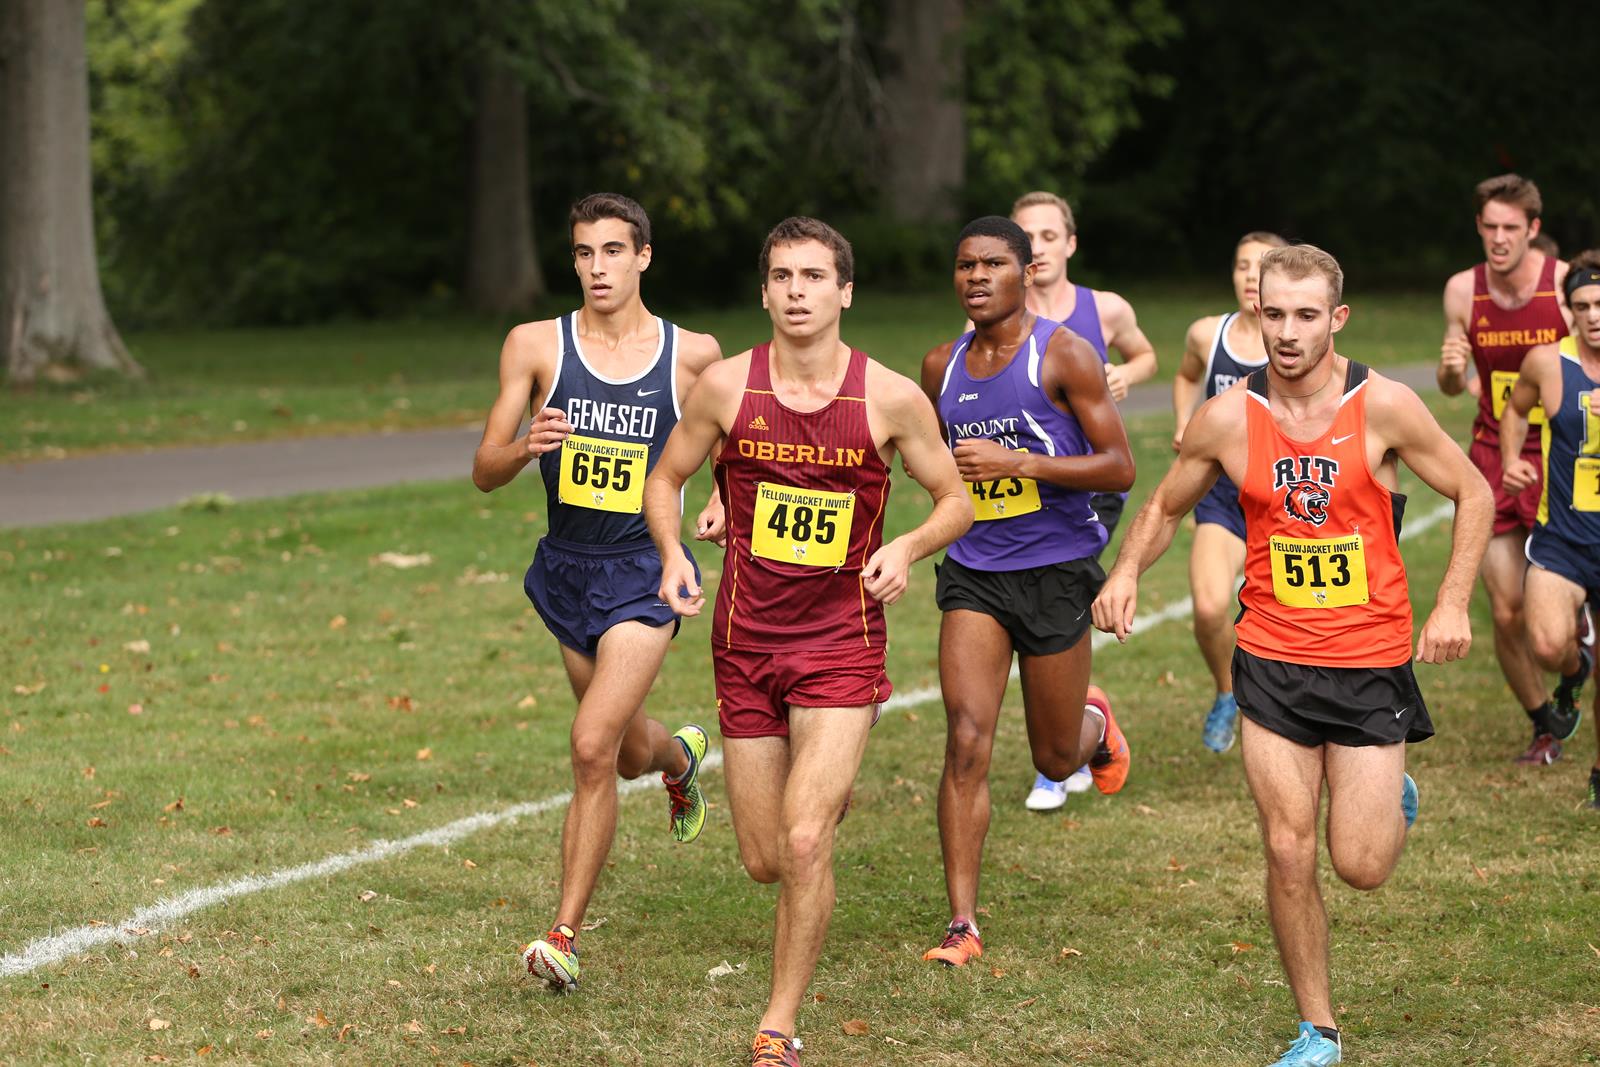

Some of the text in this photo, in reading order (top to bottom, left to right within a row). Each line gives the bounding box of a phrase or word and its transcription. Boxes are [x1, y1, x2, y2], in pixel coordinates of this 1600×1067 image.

[1477, 328, 1557, 347] OBERLIN
[567, 398, 657, 438] GENESEO
[954, 417, 1019, 438] MOUNT
[621, 449, 645, 460] INVITE
[738, 439, 866, 467] OBERLIN
[571, 452, 633, 492] 655
[1273, 456, 1339, 491] RIT
[825, 498, 851, 509] INVITE
[767, 503, 838, 545] 485
[1334, 541, 1359, 552] INVITE
[1284, 554, 1351, 587] 513
